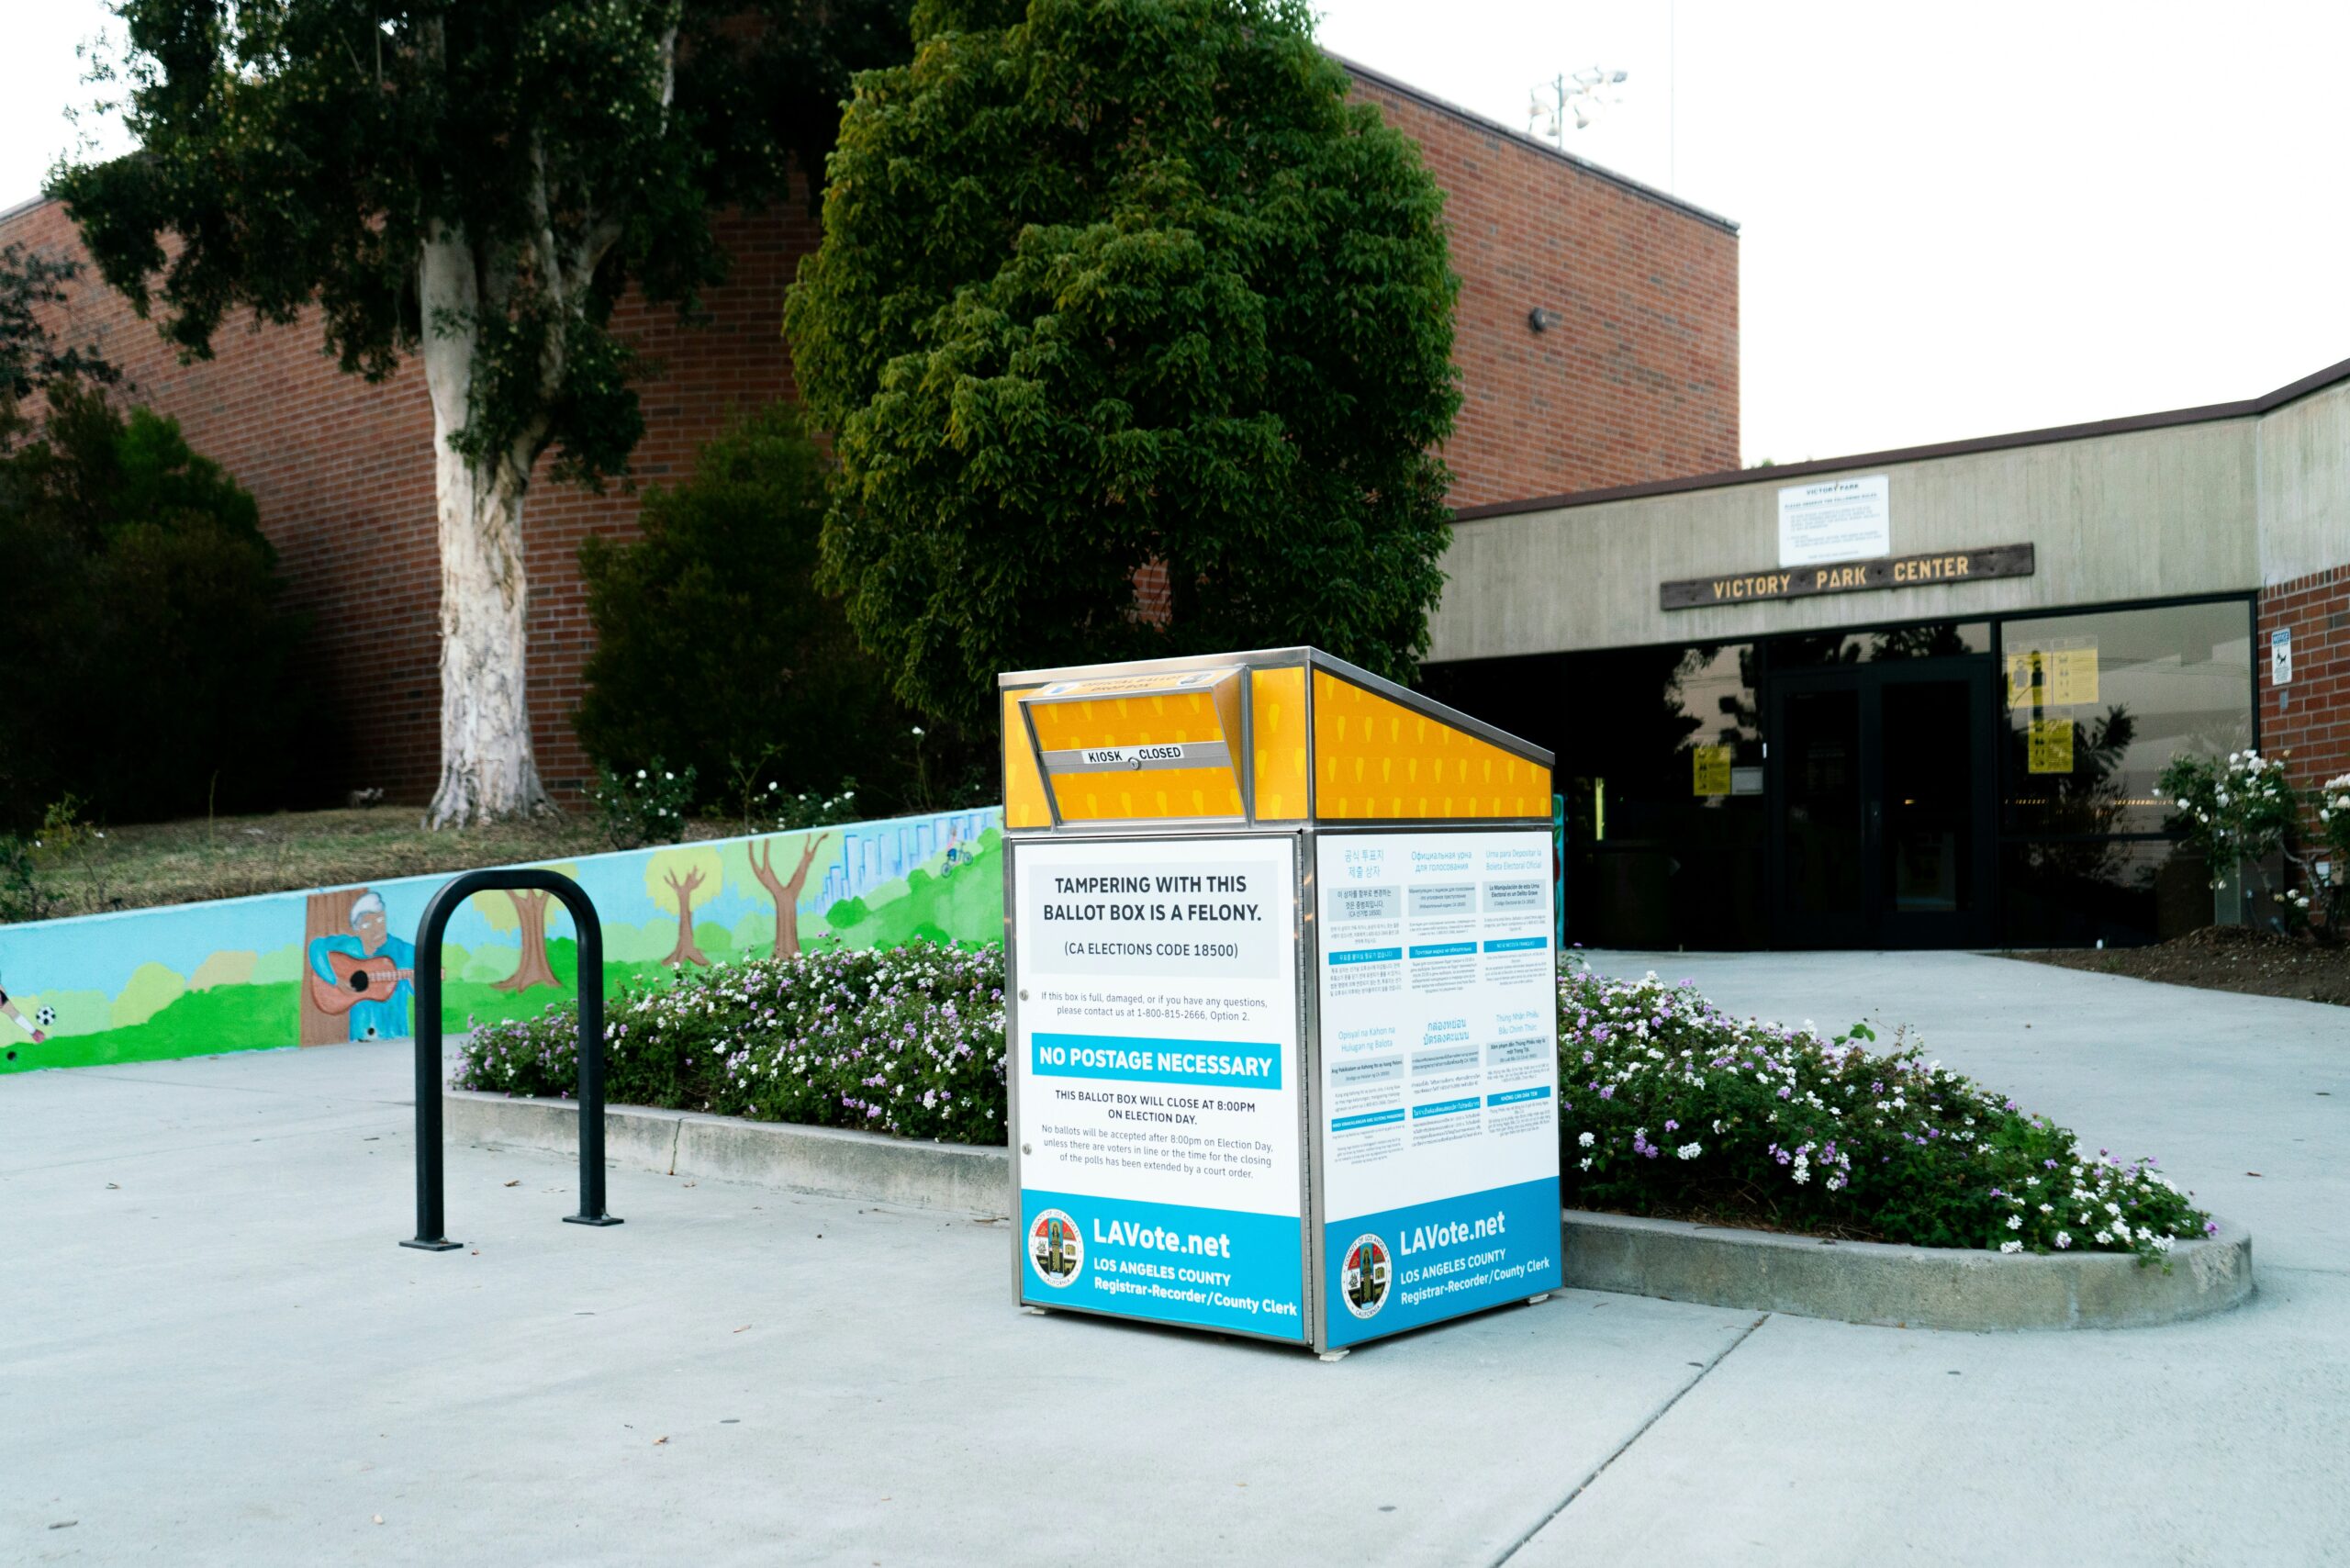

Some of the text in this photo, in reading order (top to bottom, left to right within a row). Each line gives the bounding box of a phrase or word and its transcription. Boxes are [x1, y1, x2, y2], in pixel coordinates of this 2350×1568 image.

[1806, 486, 1838, 495] VICTORY
[1714, 555, 1969, 599] VICTORY PARK CENTER
[1088, 746, 1181, 763] KIOSK CLOSED
[1345, 850, 1384, 862] 공식 투표지
[1412, 852, 1472, 860] Официальная урна
[1054, 875, 1246, 894] TAMPERING WITH THIS
[1043, 903, 1261, 921] BALLOT BOX IS A FELONY.
[1064, 941, 1238, 959] (CA ELECTIONS CODE 18500)
[1041, 990, 1267, 1008] If this box is full, damaged, or if you have any questions,
[1056, 1005, 1082, 1016] please
[1083, 1007, 1113, 1016] contact
[1126, 1008, 1135, 1017] at
[1137, 1008, 1207, 1021] 1-800-815-2666,
[1209, 1010, 1239, 1023] Option
[1241, 1011, 1250, 1021] 2.
[1338, 1030, 1360, 1040] Opisyal
[1370, 1027, 1387, 1036] Kahon
[1342, 1043, 1365, 1052] Hulugan
[1375, 1040, 1393, 1048] Balota
[1039, 1046, 1272, 1077] NO POSTAGE NECESSARY
[1054, 1089, 1255, 1113] THIS BALLOT BOX WILL CLOSE AT 8:00PM
[1107, 1108, 1197, 1125] ON ELECTION DAY.
[1041, 1123, 1273, 1154] No ballots will be accepted after 8:00pm on Election Day,
[1043, 1138, 1271, 1168] unless there are voters in line or the time for the closing
[1059, 1152, 1253, 1179] of the polls has been extended by a court order.
[1032, 1214, 1045, 1232] COUNTY
[1054, 1210, 1062, 1218] LOS
[1063, 1214, 1080, 1238] ANGELES
[1400, 1210, 1505, 1256] LAVote.net
[1093, 1217, 1230, 1258] LAVote.net
[1344, 1242, 1357, 1266] COUNTY
[1374, 1237, 1389, 1258] ANGELES
[1093, 1257, 1231, 1287] LOS ANGELES COUNTY
[1400, 1248, 1506, 1285] LOS ANGELES COUNTY
[1043, 1275, 1071, 1286] CALIFORNIA
[1400, 1256, 1550, 1305] Registrar-Recorder/County Clerk
[1094, 1275, 1297, 1316] Registrar-Recorder/County Clerk
[1355, 1305, 1380, 1317] CALIFORNIA
